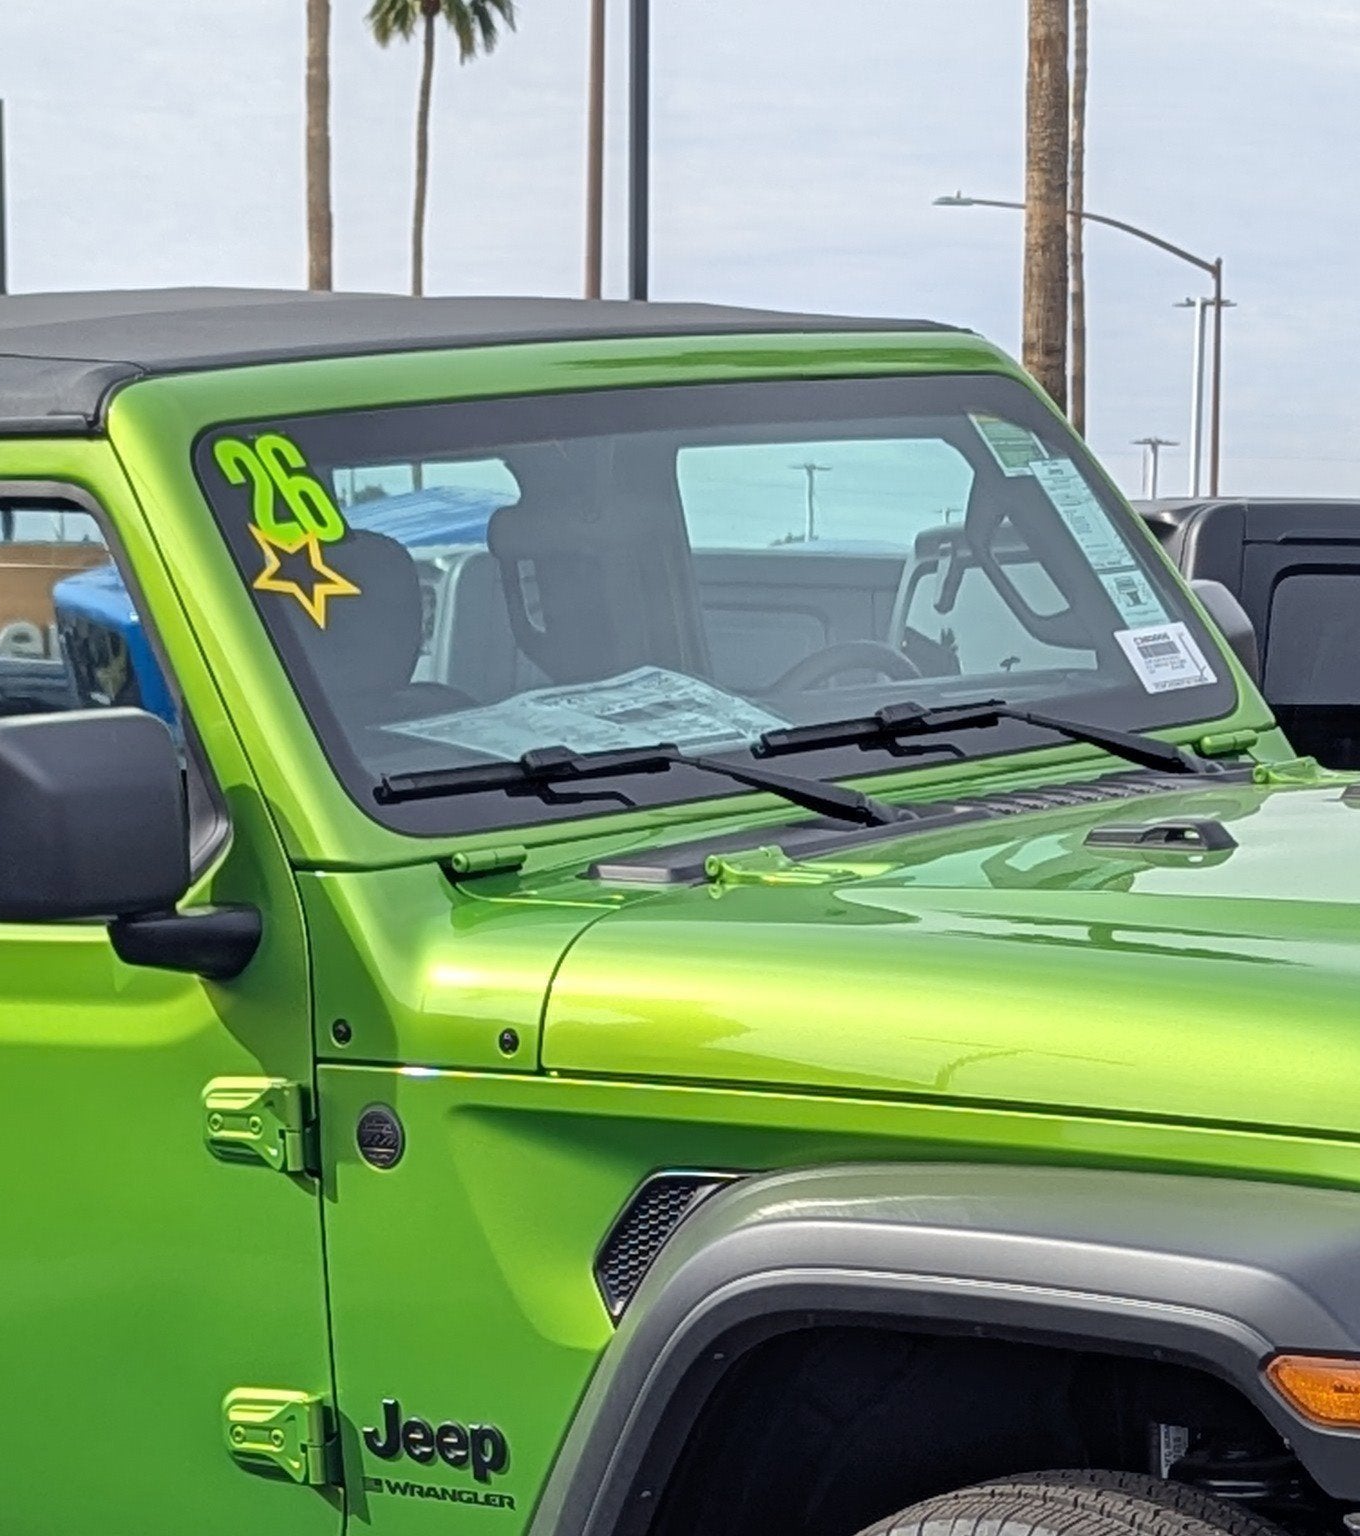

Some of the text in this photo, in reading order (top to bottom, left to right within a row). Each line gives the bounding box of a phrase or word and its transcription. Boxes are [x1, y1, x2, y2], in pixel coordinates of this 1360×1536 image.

[214, 434, 345, 545] 26
[363, 1398, 508, 1483] Jeep
[384, 1479, 516, 1511] WRANGLER
